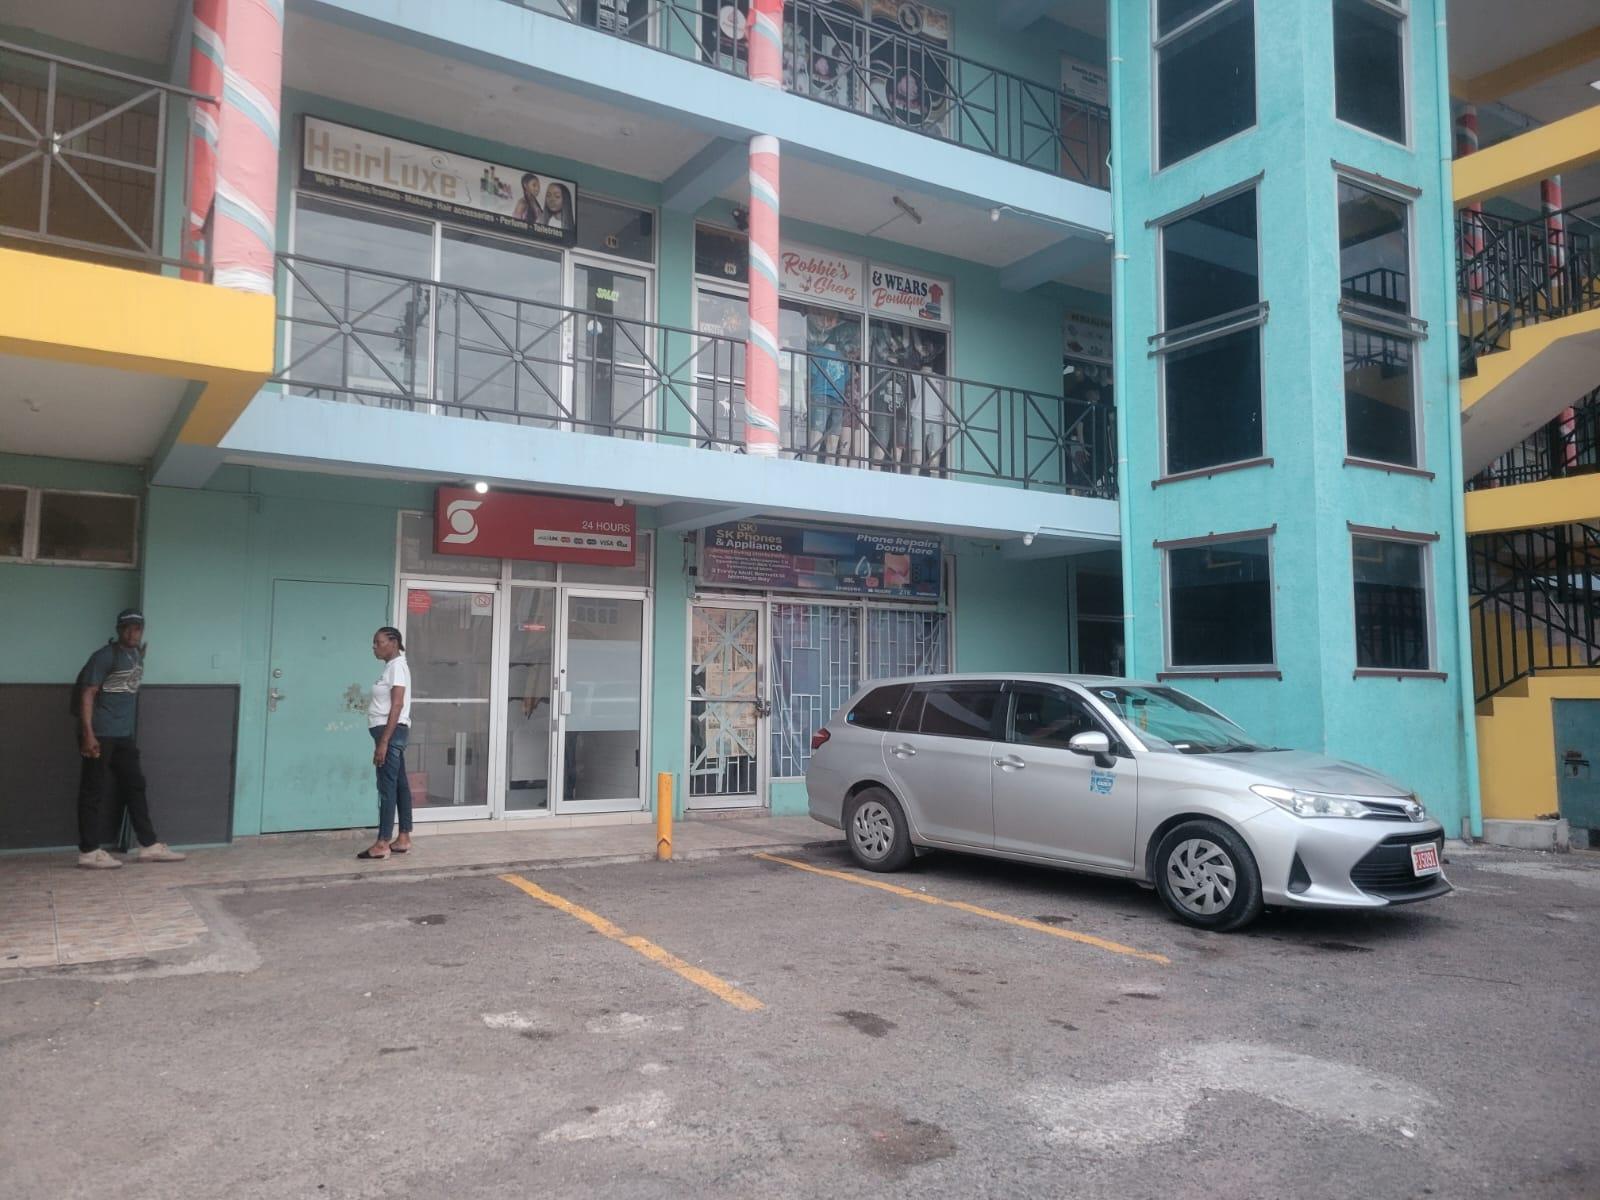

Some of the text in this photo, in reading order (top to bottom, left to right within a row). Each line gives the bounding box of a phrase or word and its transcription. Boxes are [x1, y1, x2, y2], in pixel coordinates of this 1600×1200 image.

[307, 127, 457, 199] HairLuxe
[437, 199, 452, 212] Hair
[453, 207, 495, 222] accessories
[500, 216, 529, 230] Perfume
[534, 223, 563, 238] Toiletries
[782, 252, 849, 280] Robbie's
[814, 277, 857, 301] Shoes
[872, 271, 928, 297] & WEARS
[872, 287, 926, 310] Boutique
[582, 520, 631, 533] 24 HOURS
[716, 529, 782, 544] SK Phones
[715, 538, 724, 546] &
[726, 539, 783, 552] Appliance
[856, 534, 939, 549] Phone Repairs
[875, 543, 906, 553] Done
